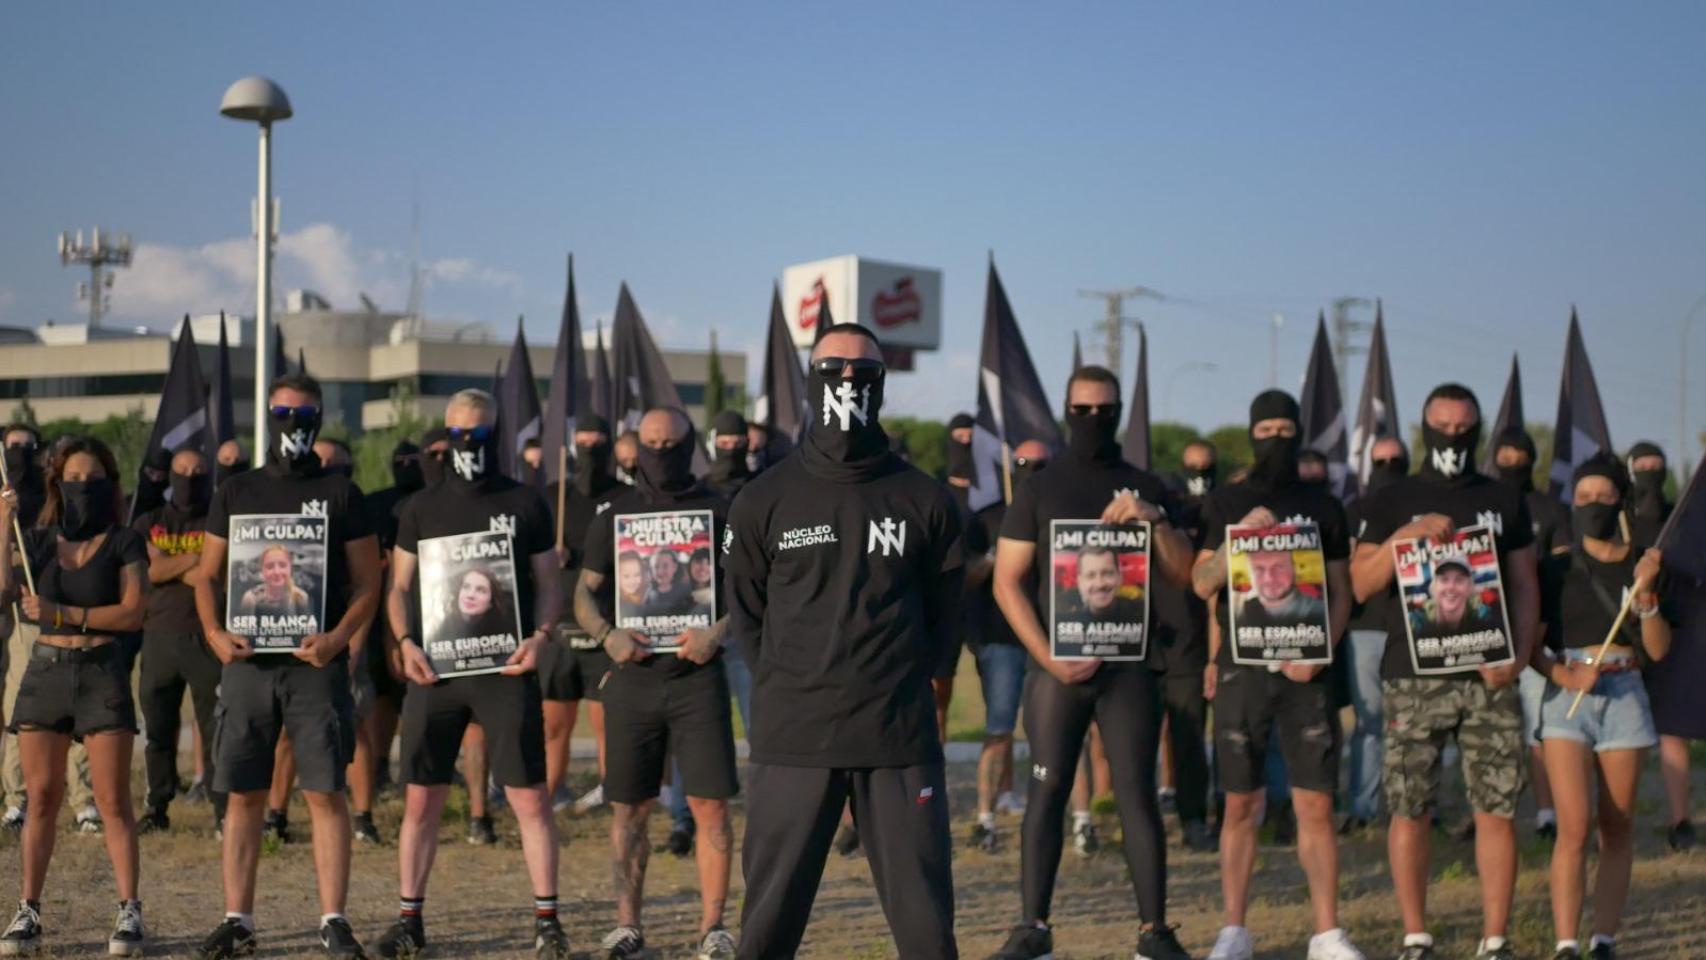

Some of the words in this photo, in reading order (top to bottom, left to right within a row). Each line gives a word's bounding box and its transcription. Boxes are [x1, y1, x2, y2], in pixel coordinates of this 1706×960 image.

[233, 525, 260, 543] ¿MI
[264, 524, 324, 540] CULPA?
[624, 516, 704, 538] ¿NUESTRA
[783, 524, 832, 540] NÚCLEO
[634, 530, 694, 547] CULPA?
[778, 533, 839, 551] NACIONAL
[1055, 530, 1083, 550] ¿MI
[1086, 530, 1146, 548] CULPA?
[1231, 535, 1259, 555] ¿MI
[1262, 533, 1319, 550] CULPA?
[451, 539, 508, 561] CULPA?
[1430, 535, 1490, 561] CULPA?
[233, 615, 257, 628] SER
[260, 614, 318, 628] BLANCA
[1057, 621, 1084, 635] SER
[1238, 626, 1263, 640] SER
[1264, 622, 1324, 640] ESPAÑOL
[430, 639, 454, 652] SER
[455, 633, 516, 651] EUROPEA
[1417, 637, 1440, 649] SER
